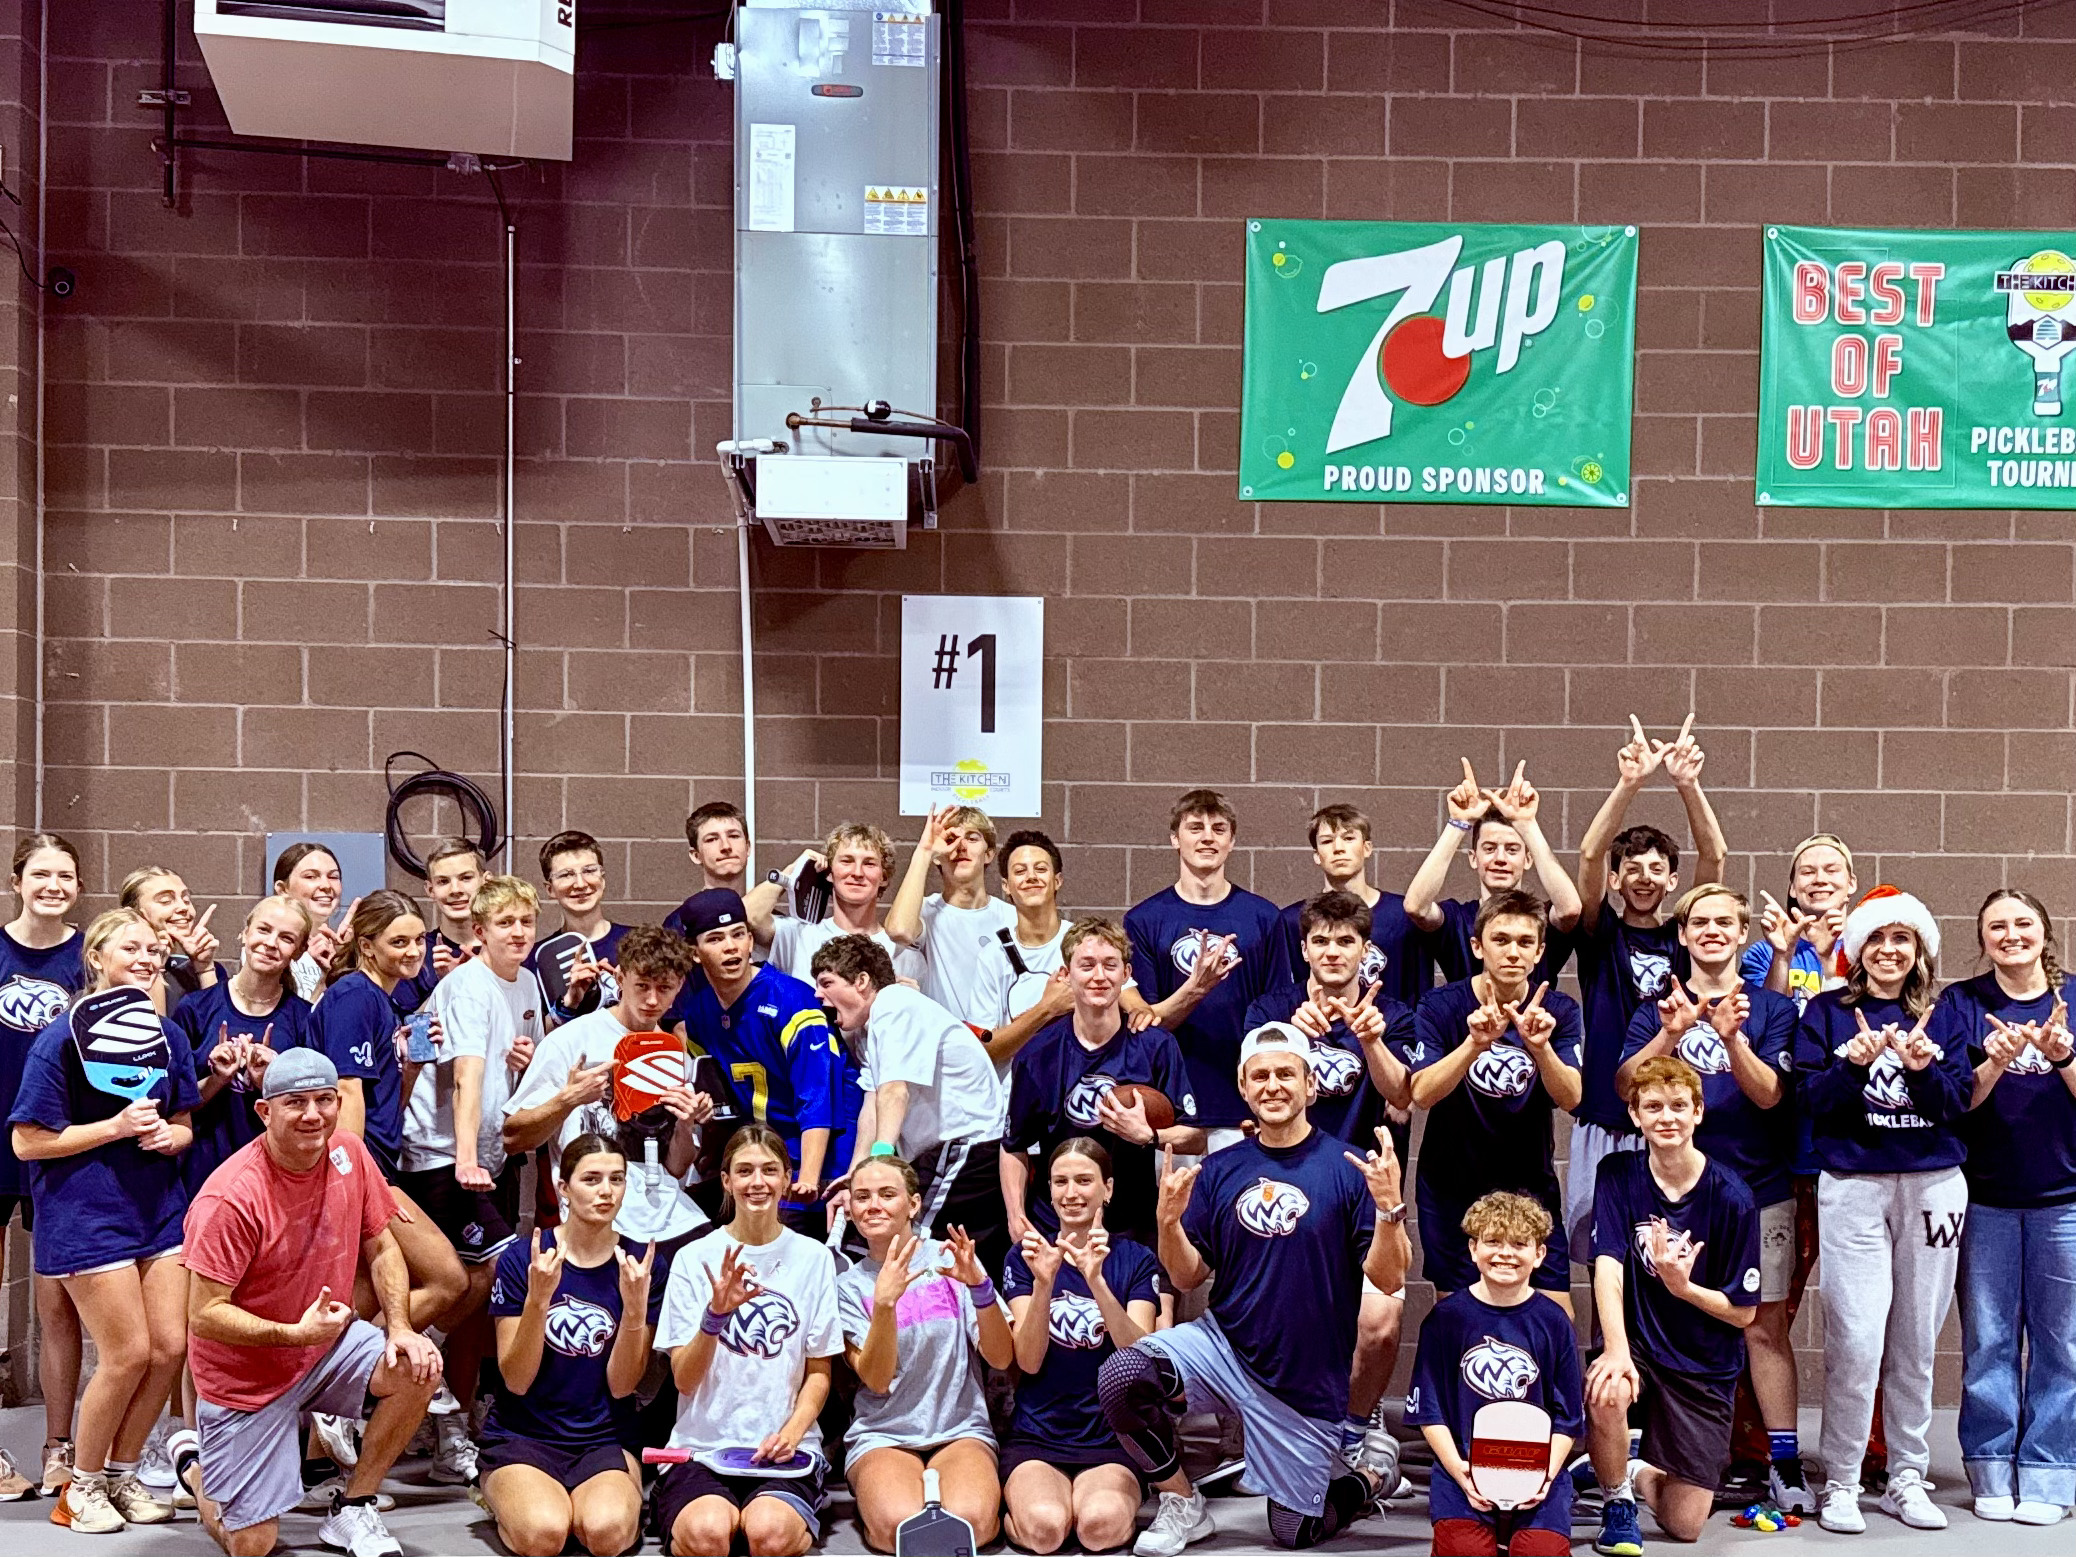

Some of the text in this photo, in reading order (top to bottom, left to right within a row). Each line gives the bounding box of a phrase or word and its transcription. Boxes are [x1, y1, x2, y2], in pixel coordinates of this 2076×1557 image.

[1792, 261, 1945, 327] BEST
[2001, 275, 2029, 290] THE
[1831, 333, 1903, 398] OF
[1786, 405, 1944, 471] UTAH
[1323, 464, 1545, 495] PROUD SPONSOR
[932, 634, 996, 733] #1
[935, 773, 1007, 786] THE KITCHEN
[730, 1061, 769, 1122] 7
[1921, 1210, 1963, 1248] WX
